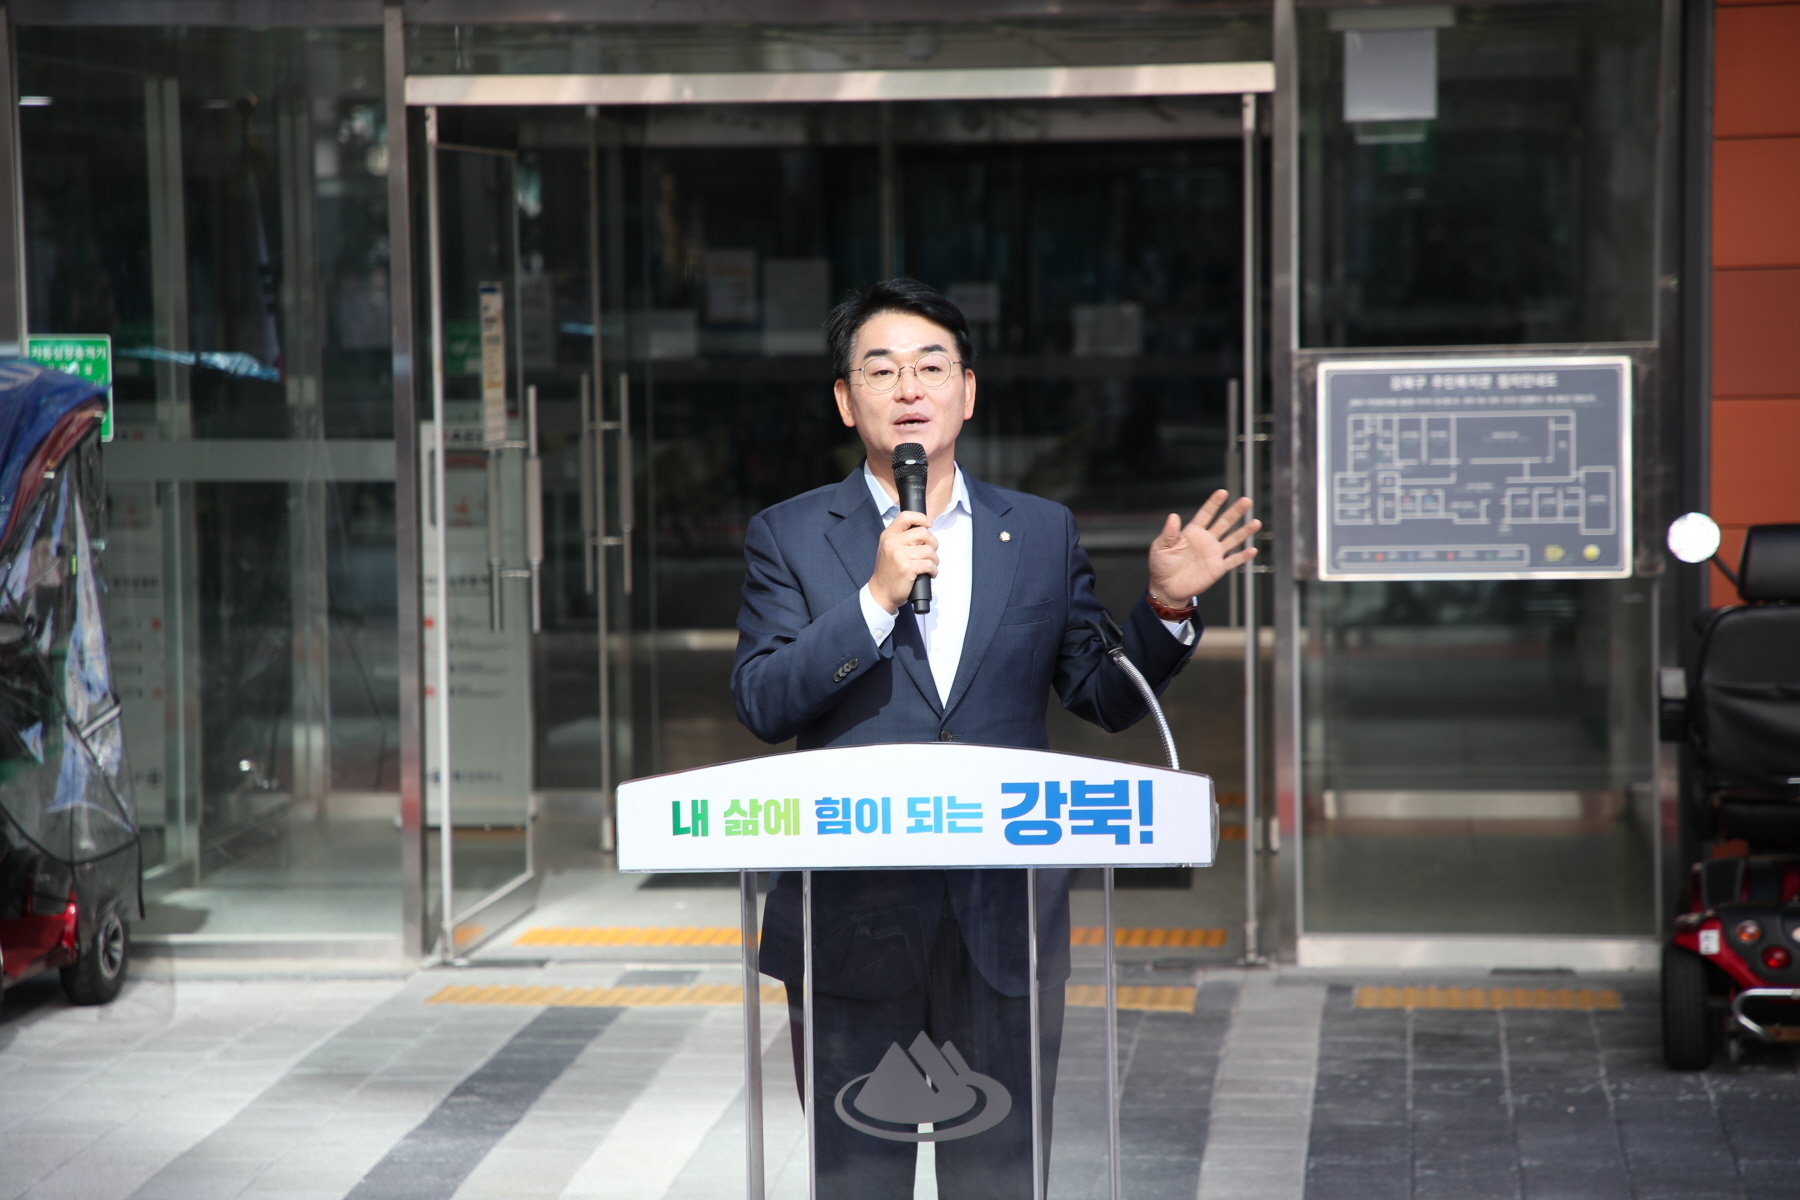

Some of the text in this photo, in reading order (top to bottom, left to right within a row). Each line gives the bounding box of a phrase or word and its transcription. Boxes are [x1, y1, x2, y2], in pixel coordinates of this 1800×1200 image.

[672, 779, 1154, 846] 내 삶에 힘이 되는 강북!
